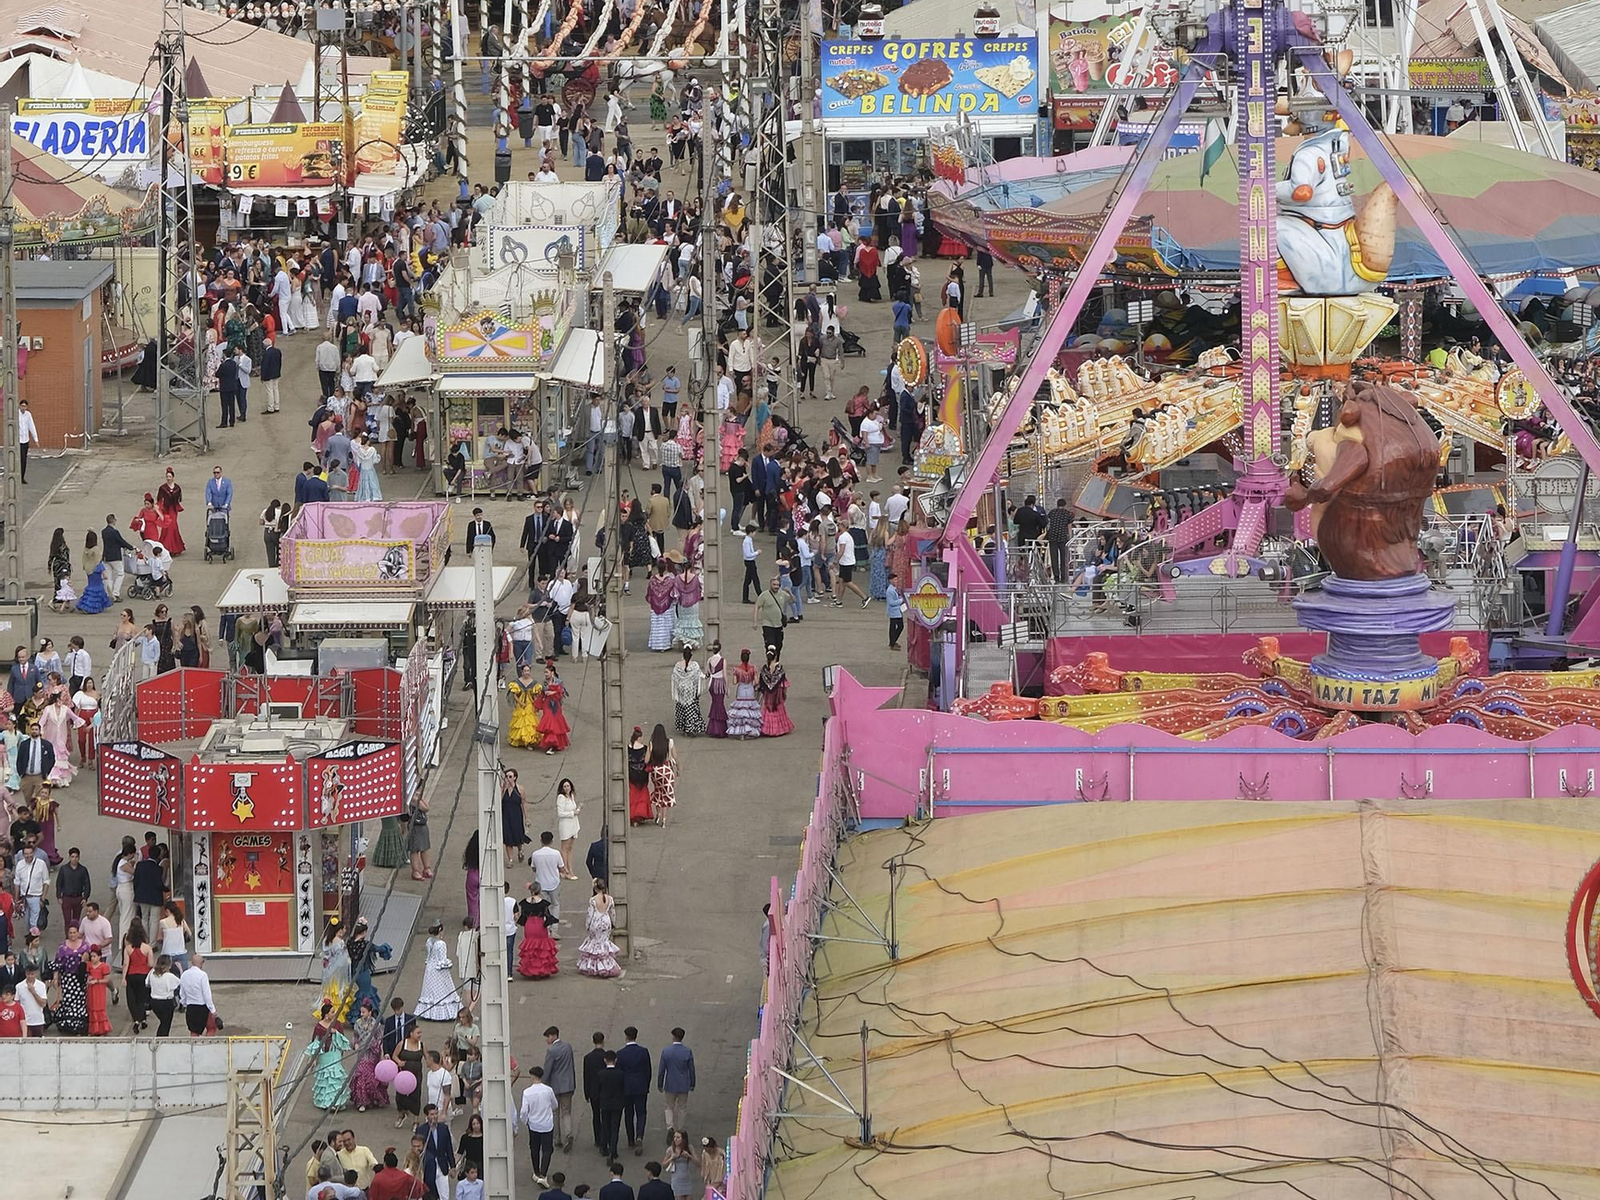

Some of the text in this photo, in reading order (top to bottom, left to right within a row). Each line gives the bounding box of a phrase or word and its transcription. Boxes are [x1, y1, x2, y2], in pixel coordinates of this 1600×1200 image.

[860, 20, 883, 28] nutella
[975, 18, 998, 26] nutella
[1059, 28, 1097, 40] Batidos
[829, 42, 1028, 62] CREPES GOFRES CREPES
[829, 57, 856, 66] nutella
[860, 93, 1000, 115] BELINDA
[13, 120, 145, 155] ELADERIA
[1362, 688, 1400, 705] TAZ
[112, 743, 138, 756] MAGIC
[325, 745, 354, 759] MAGIC
[233, 835, 272, 847] GAMES
